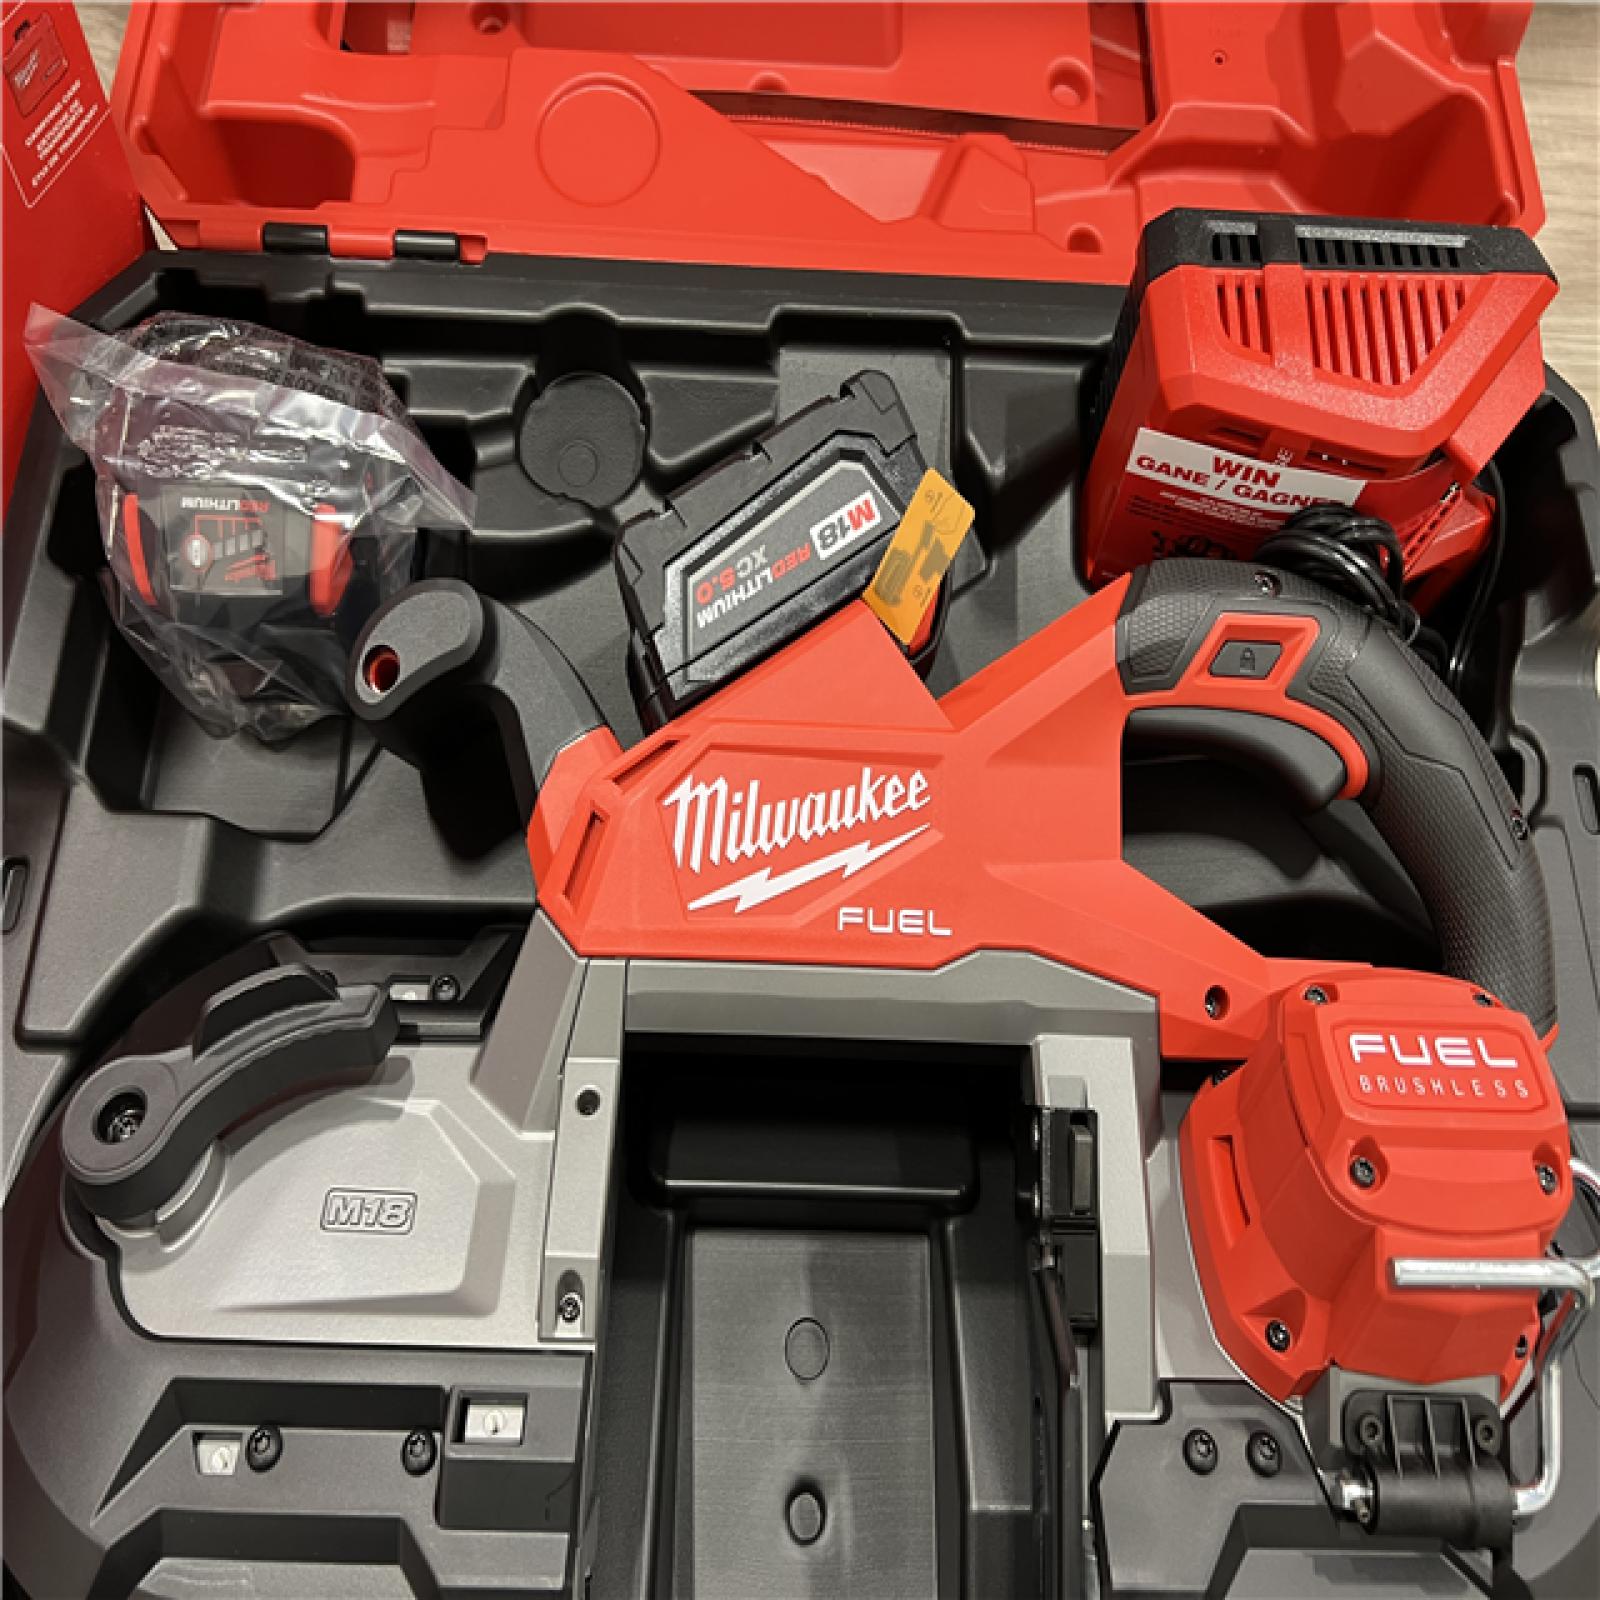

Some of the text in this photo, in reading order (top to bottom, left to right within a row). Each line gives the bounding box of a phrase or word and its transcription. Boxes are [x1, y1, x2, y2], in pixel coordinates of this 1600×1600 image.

[1136, 454, 1211, 487] GANE
[1232, 484, 1345, 507] GAGN
[1213, 455, 1281, 488] WIN
[696, 498, 877, 629] M18 REDLITHIUM
[662, 766, 932, 874] Milwaukee
[836, 906, 953, 937] FUEL
[1349, 1032, 1519, 1069] FUEL
[1358, 1073, 1530, 1099] BRUSHLESS
[325, 1196, 411, 1229] M18
